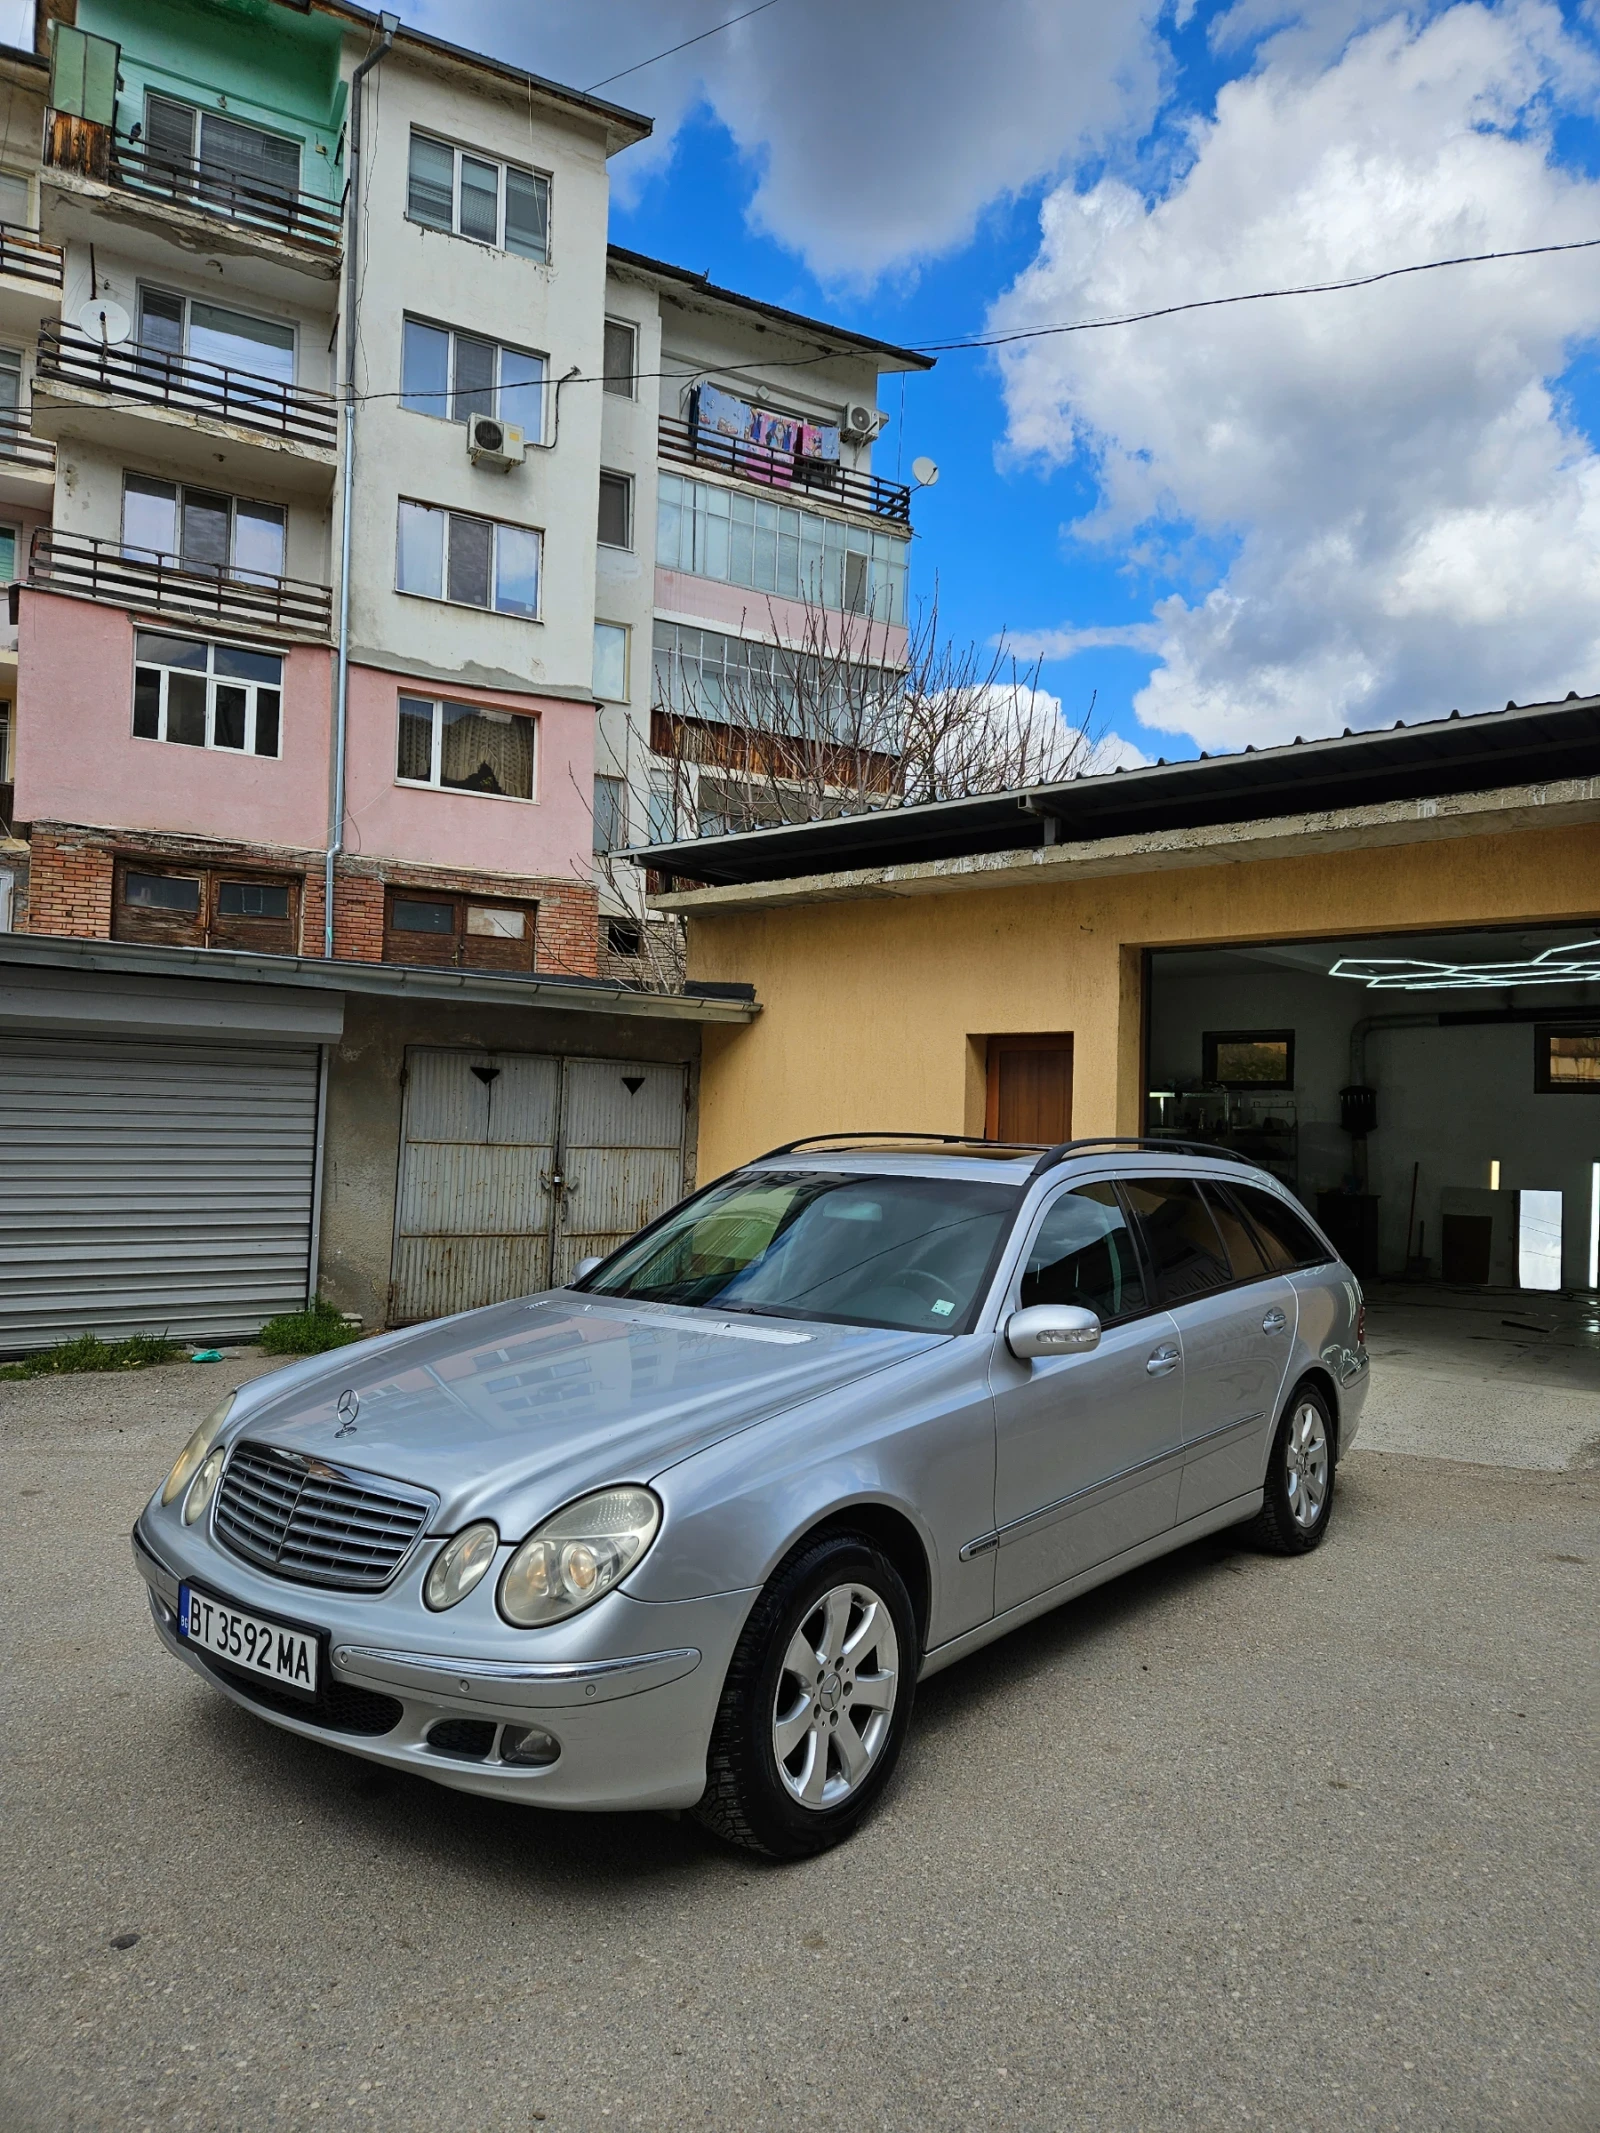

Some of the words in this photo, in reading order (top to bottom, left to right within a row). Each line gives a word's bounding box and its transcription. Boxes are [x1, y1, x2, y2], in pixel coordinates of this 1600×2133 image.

[190, 1596, 214, 1643] BT
[216, 1611, 273, 1670] 3592
[276, 1633, 310, 1684] MA
